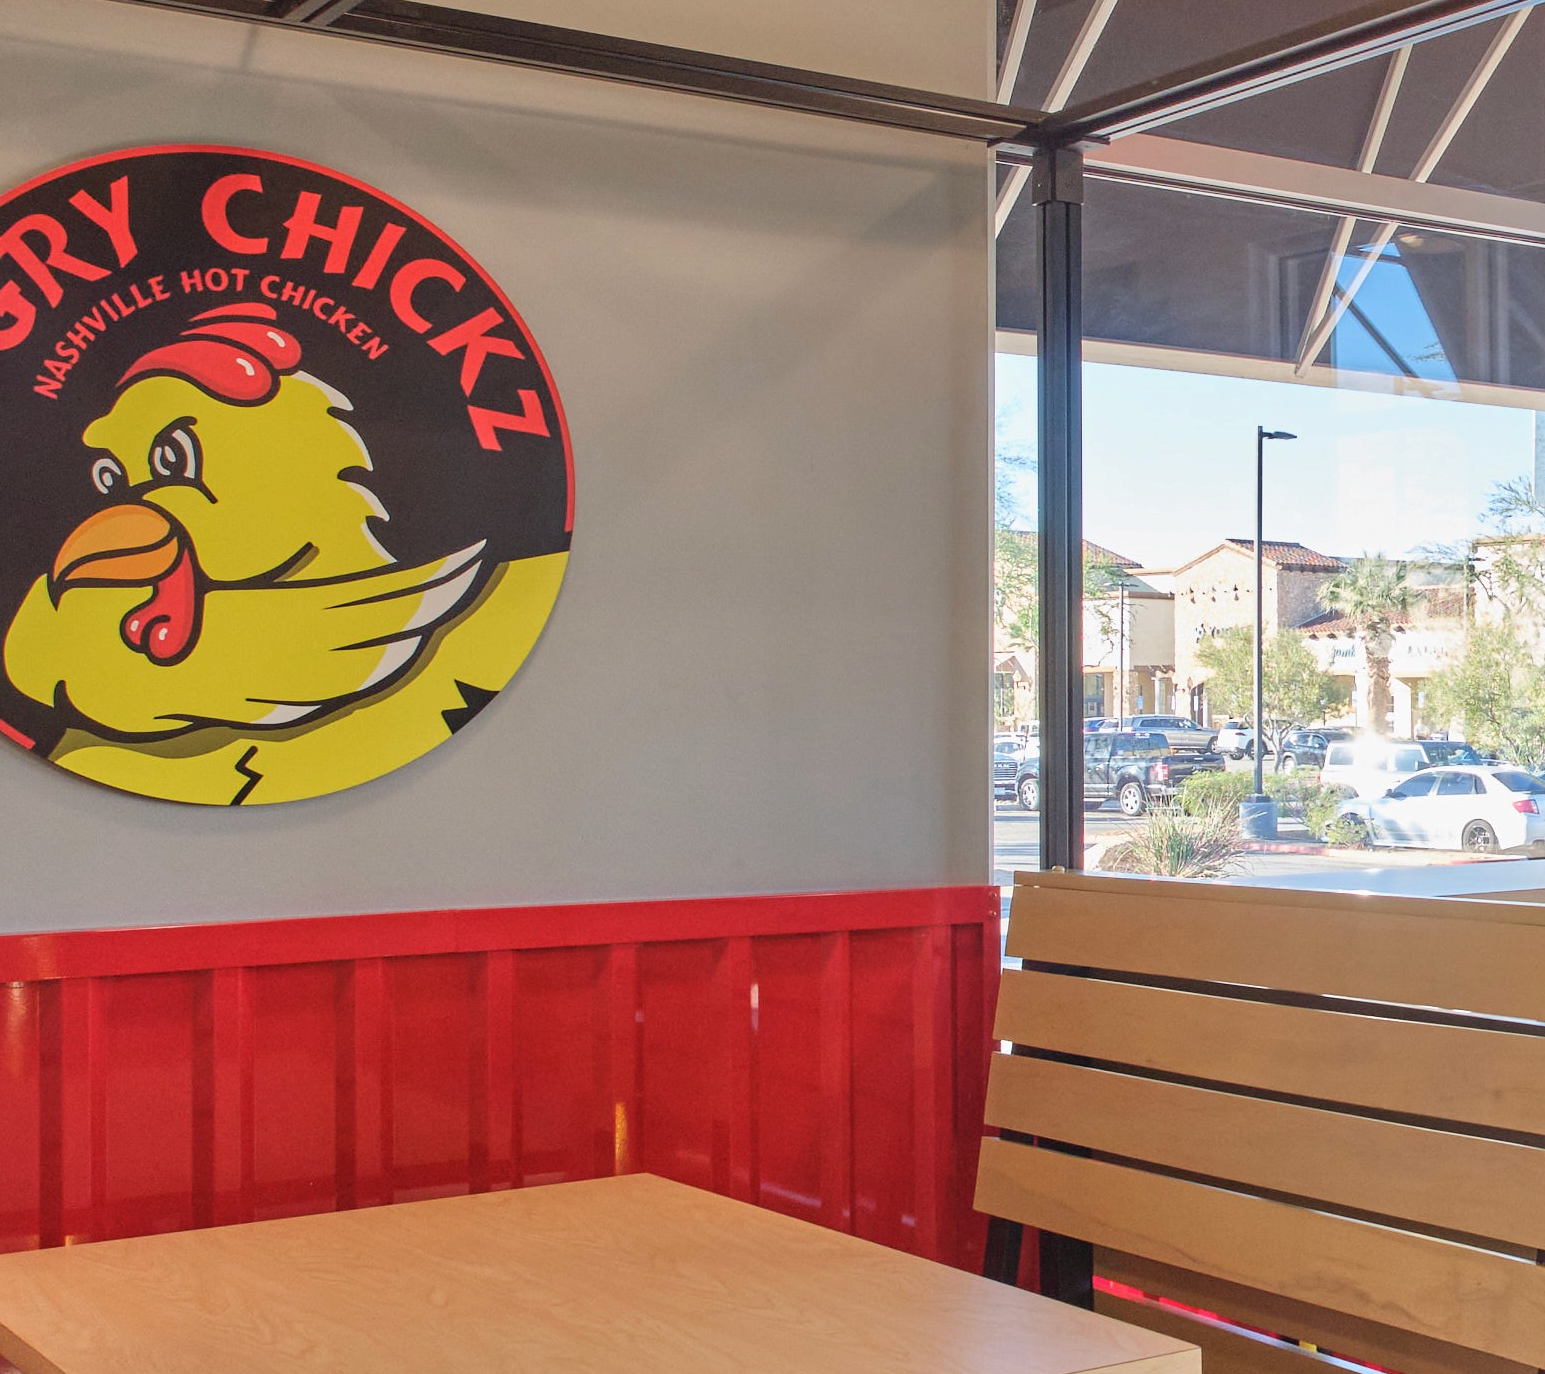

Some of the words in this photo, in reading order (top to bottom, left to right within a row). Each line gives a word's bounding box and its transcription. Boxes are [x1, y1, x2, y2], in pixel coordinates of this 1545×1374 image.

[32, 274, 172, 400] NASHVILLE
[180, 267, 251, 294] HOT
[259, 274, 390, 361] CHICKEN
[200, 172, 550, 453] CHICKZ
